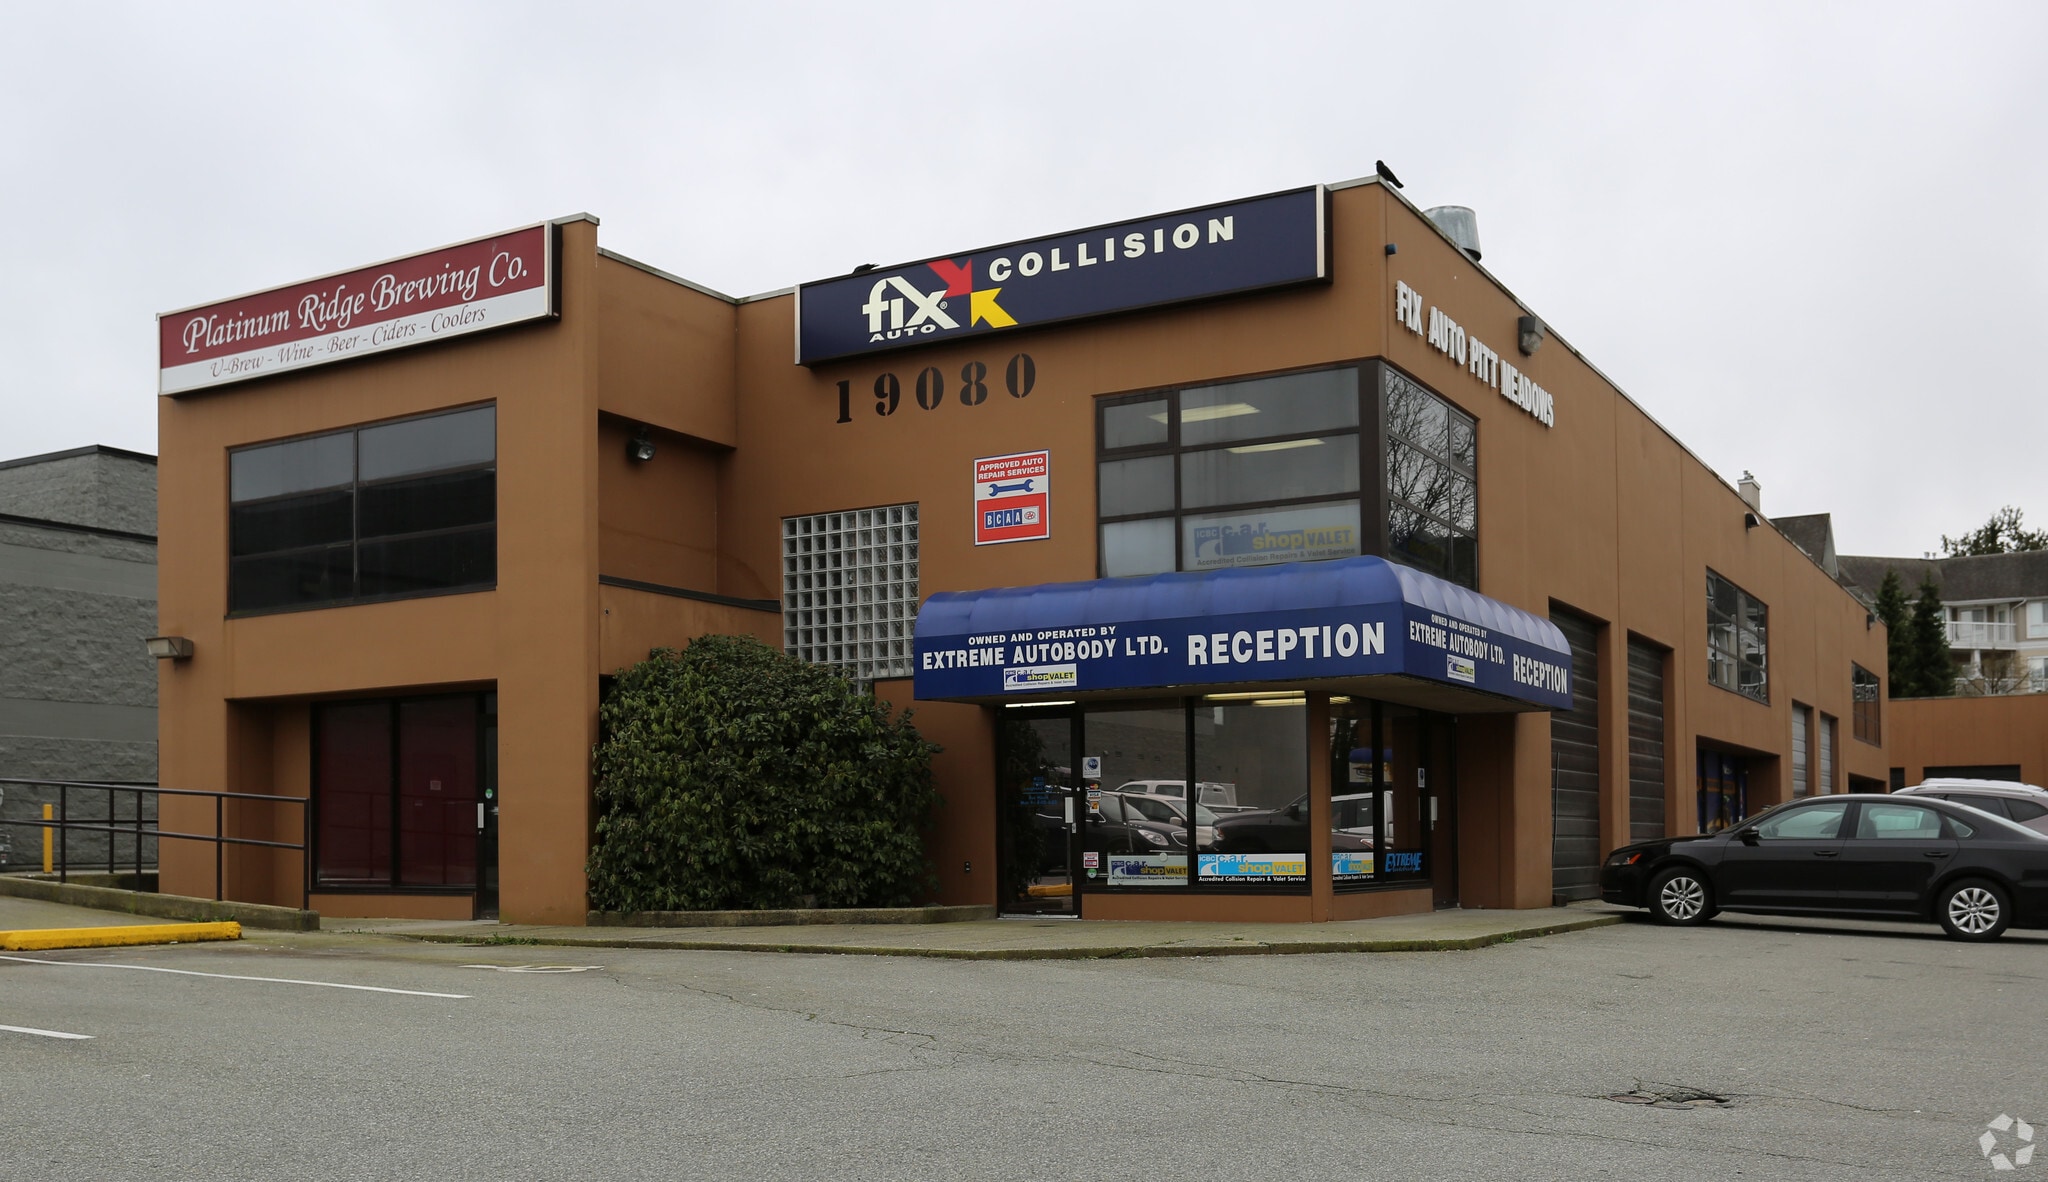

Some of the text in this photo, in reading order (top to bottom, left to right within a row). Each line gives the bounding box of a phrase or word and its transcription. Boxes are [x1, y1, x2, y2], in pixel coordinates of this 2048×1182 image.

[988, 215, 1234, 282] COLLISION
[183, 251, 528, 354] Platinum Ridge Brewing Co.
[277, 344, 314, 364] Wine
[326, 333, 360, 353] Beer
[371, 320, 416, 346] Ciders
[430, 305, 486, 333] Coolers
[869, 324, 937, 343] AUTO
[1396, 280, 1554, 428] FIX AUTO PITT MEADOWS
[835, 353, 1036, 423] 19080
[978, 466, 1044, 480] REPAIR SERVICES
[979, 457, 1043, 471] APPROVED AUTO
[987, 512, 1020, 525] BCAA
[1252, 529, 1351, 551] shop VALET
[968, 626, 1116, 646] OWNED AND OPERATED BY
[1431, 614, 1447, 626] OWNED
[1459, 622, 1480, 636] OPERATED
[923, 635, 1169, 670] EXTREME AUTOBODY LTD.
[1187, 621, 1385, 666] RECEPTION
[1410, 620, 1505, 664] EXTREME AUTOBODY LTD.
[1049, 672, 1074, 680] VALET
[1513, 653, 1568, 695] RECEPTION
[1140, 865, 1187, 876] shop VALET
[1238, 862, 1304, 875] shop VALET
[1385, 852, 1422, 873] EXTREME
